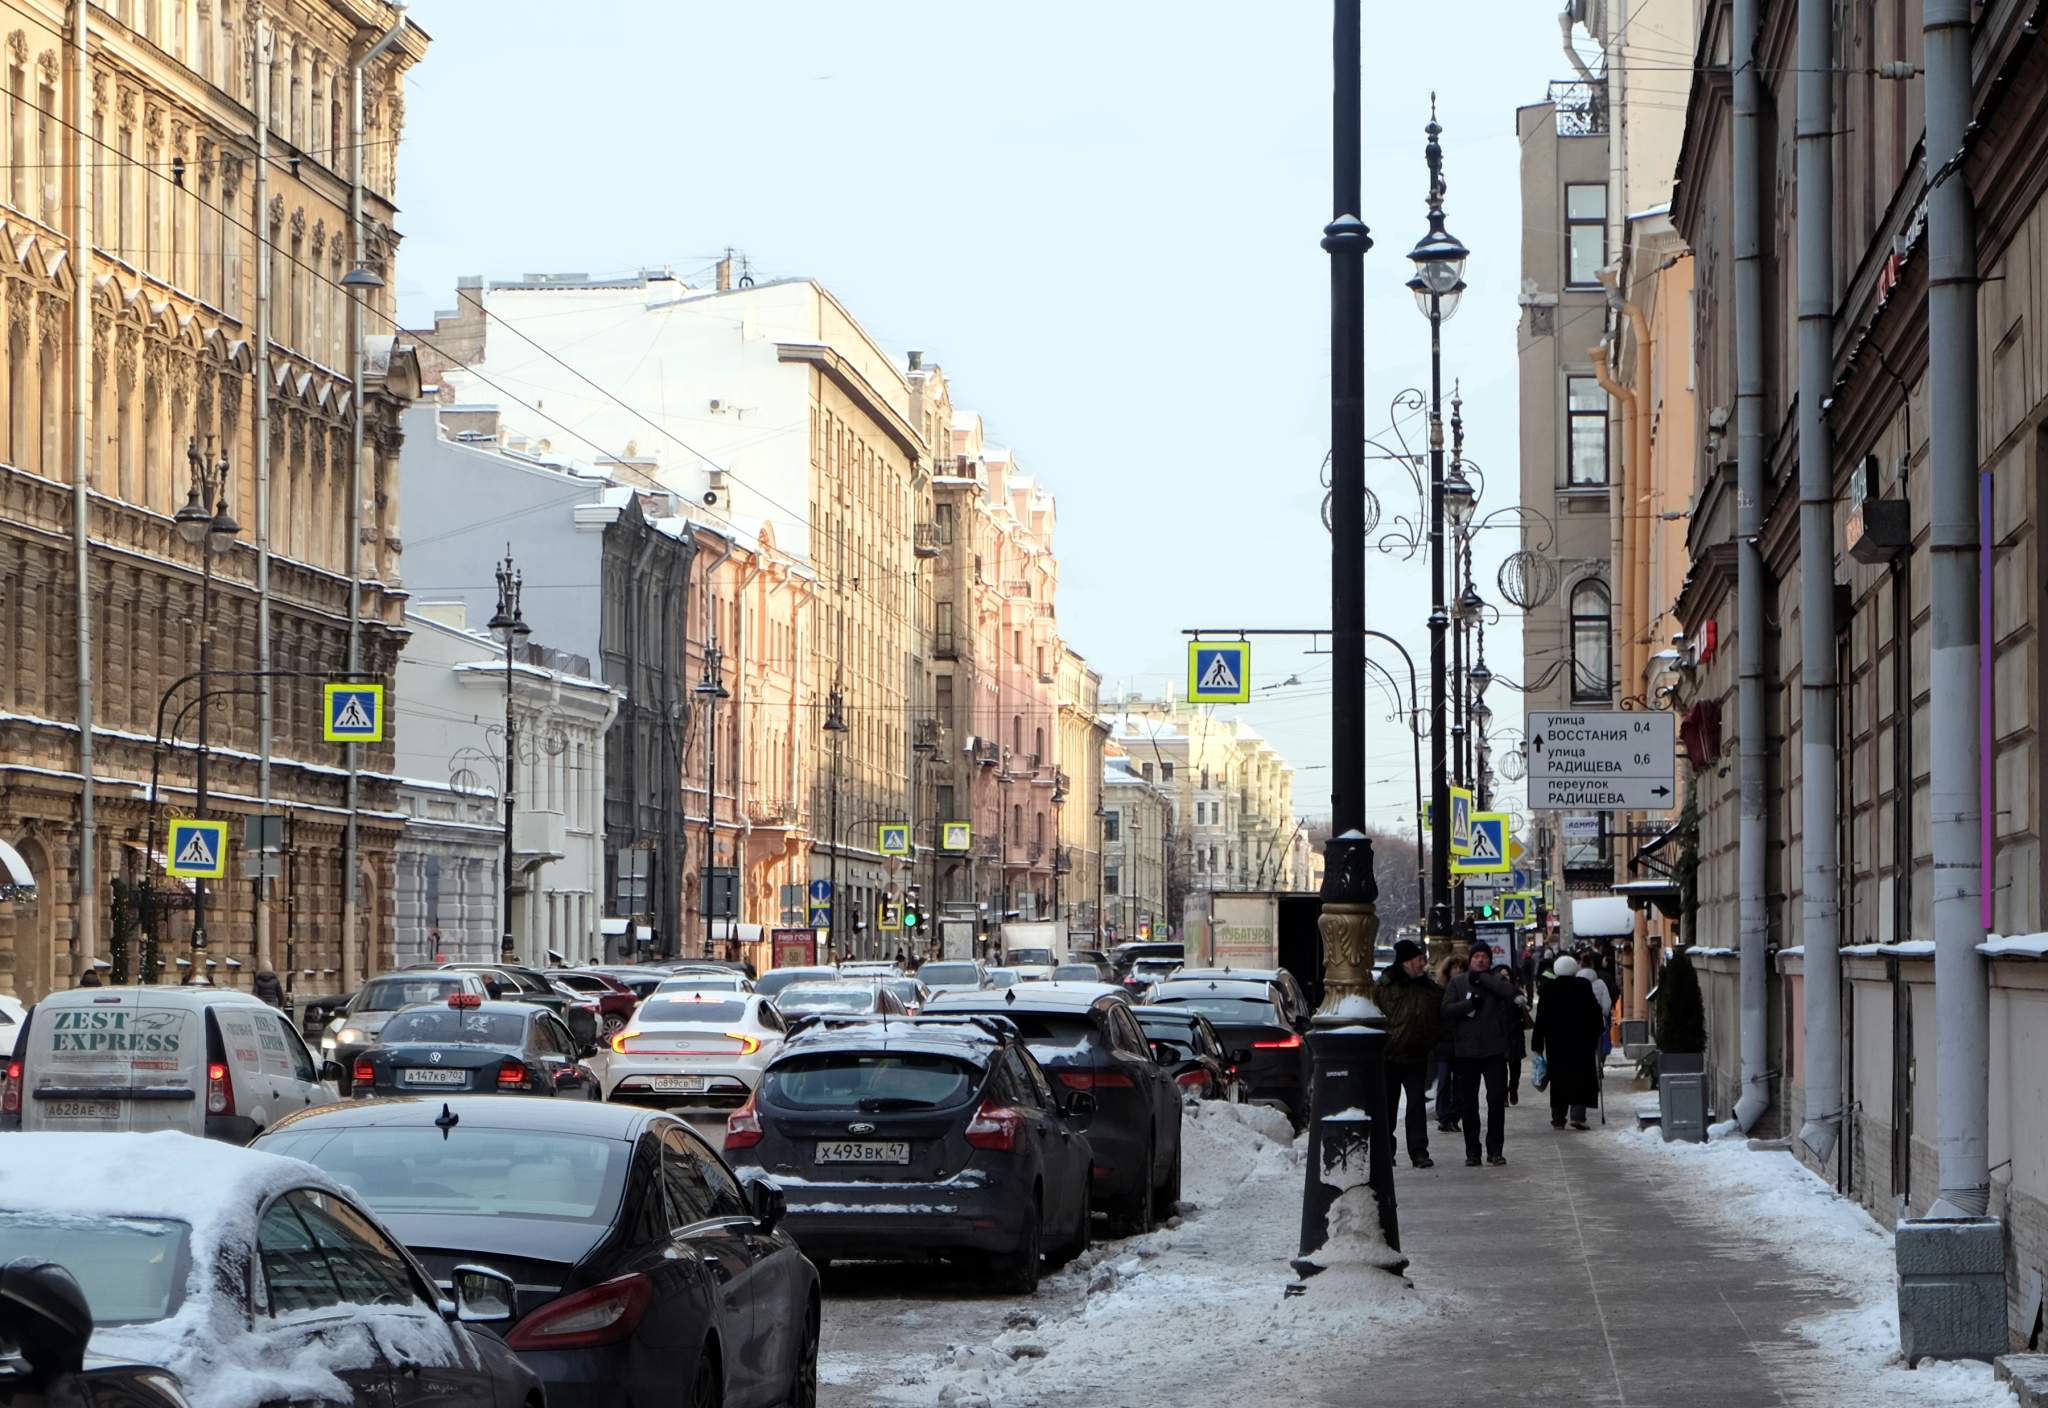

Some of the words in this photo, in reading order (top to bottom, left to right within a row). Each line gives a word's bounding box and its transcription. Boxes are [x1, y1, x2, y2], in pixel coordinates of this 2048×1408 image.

[1547, 716, 1585, 727] улица
[1634, 721, 1650, 734] 0,4
[1548, 730, 1627, 741] ВОССТАНИЯ
[1548, 748, 1585, 760] улица
[1634, 753, 1650, 766] 0,6
[1548, 761, 1622, 773] РАДИЩЕВА
[1548, 780, 1609, 791] переулок
[1548, 792, 1625, 805] РАДИЩЕВА
[54, 1012, 130, 1030] ZEST
[52, 1033, 180, 1052] EXPRESS
[48, 1103, 95, 1116] А628АЕ
[822, 1143, 884, 1160] Х493ВК
[889, 1143, 905, 1156] 47
